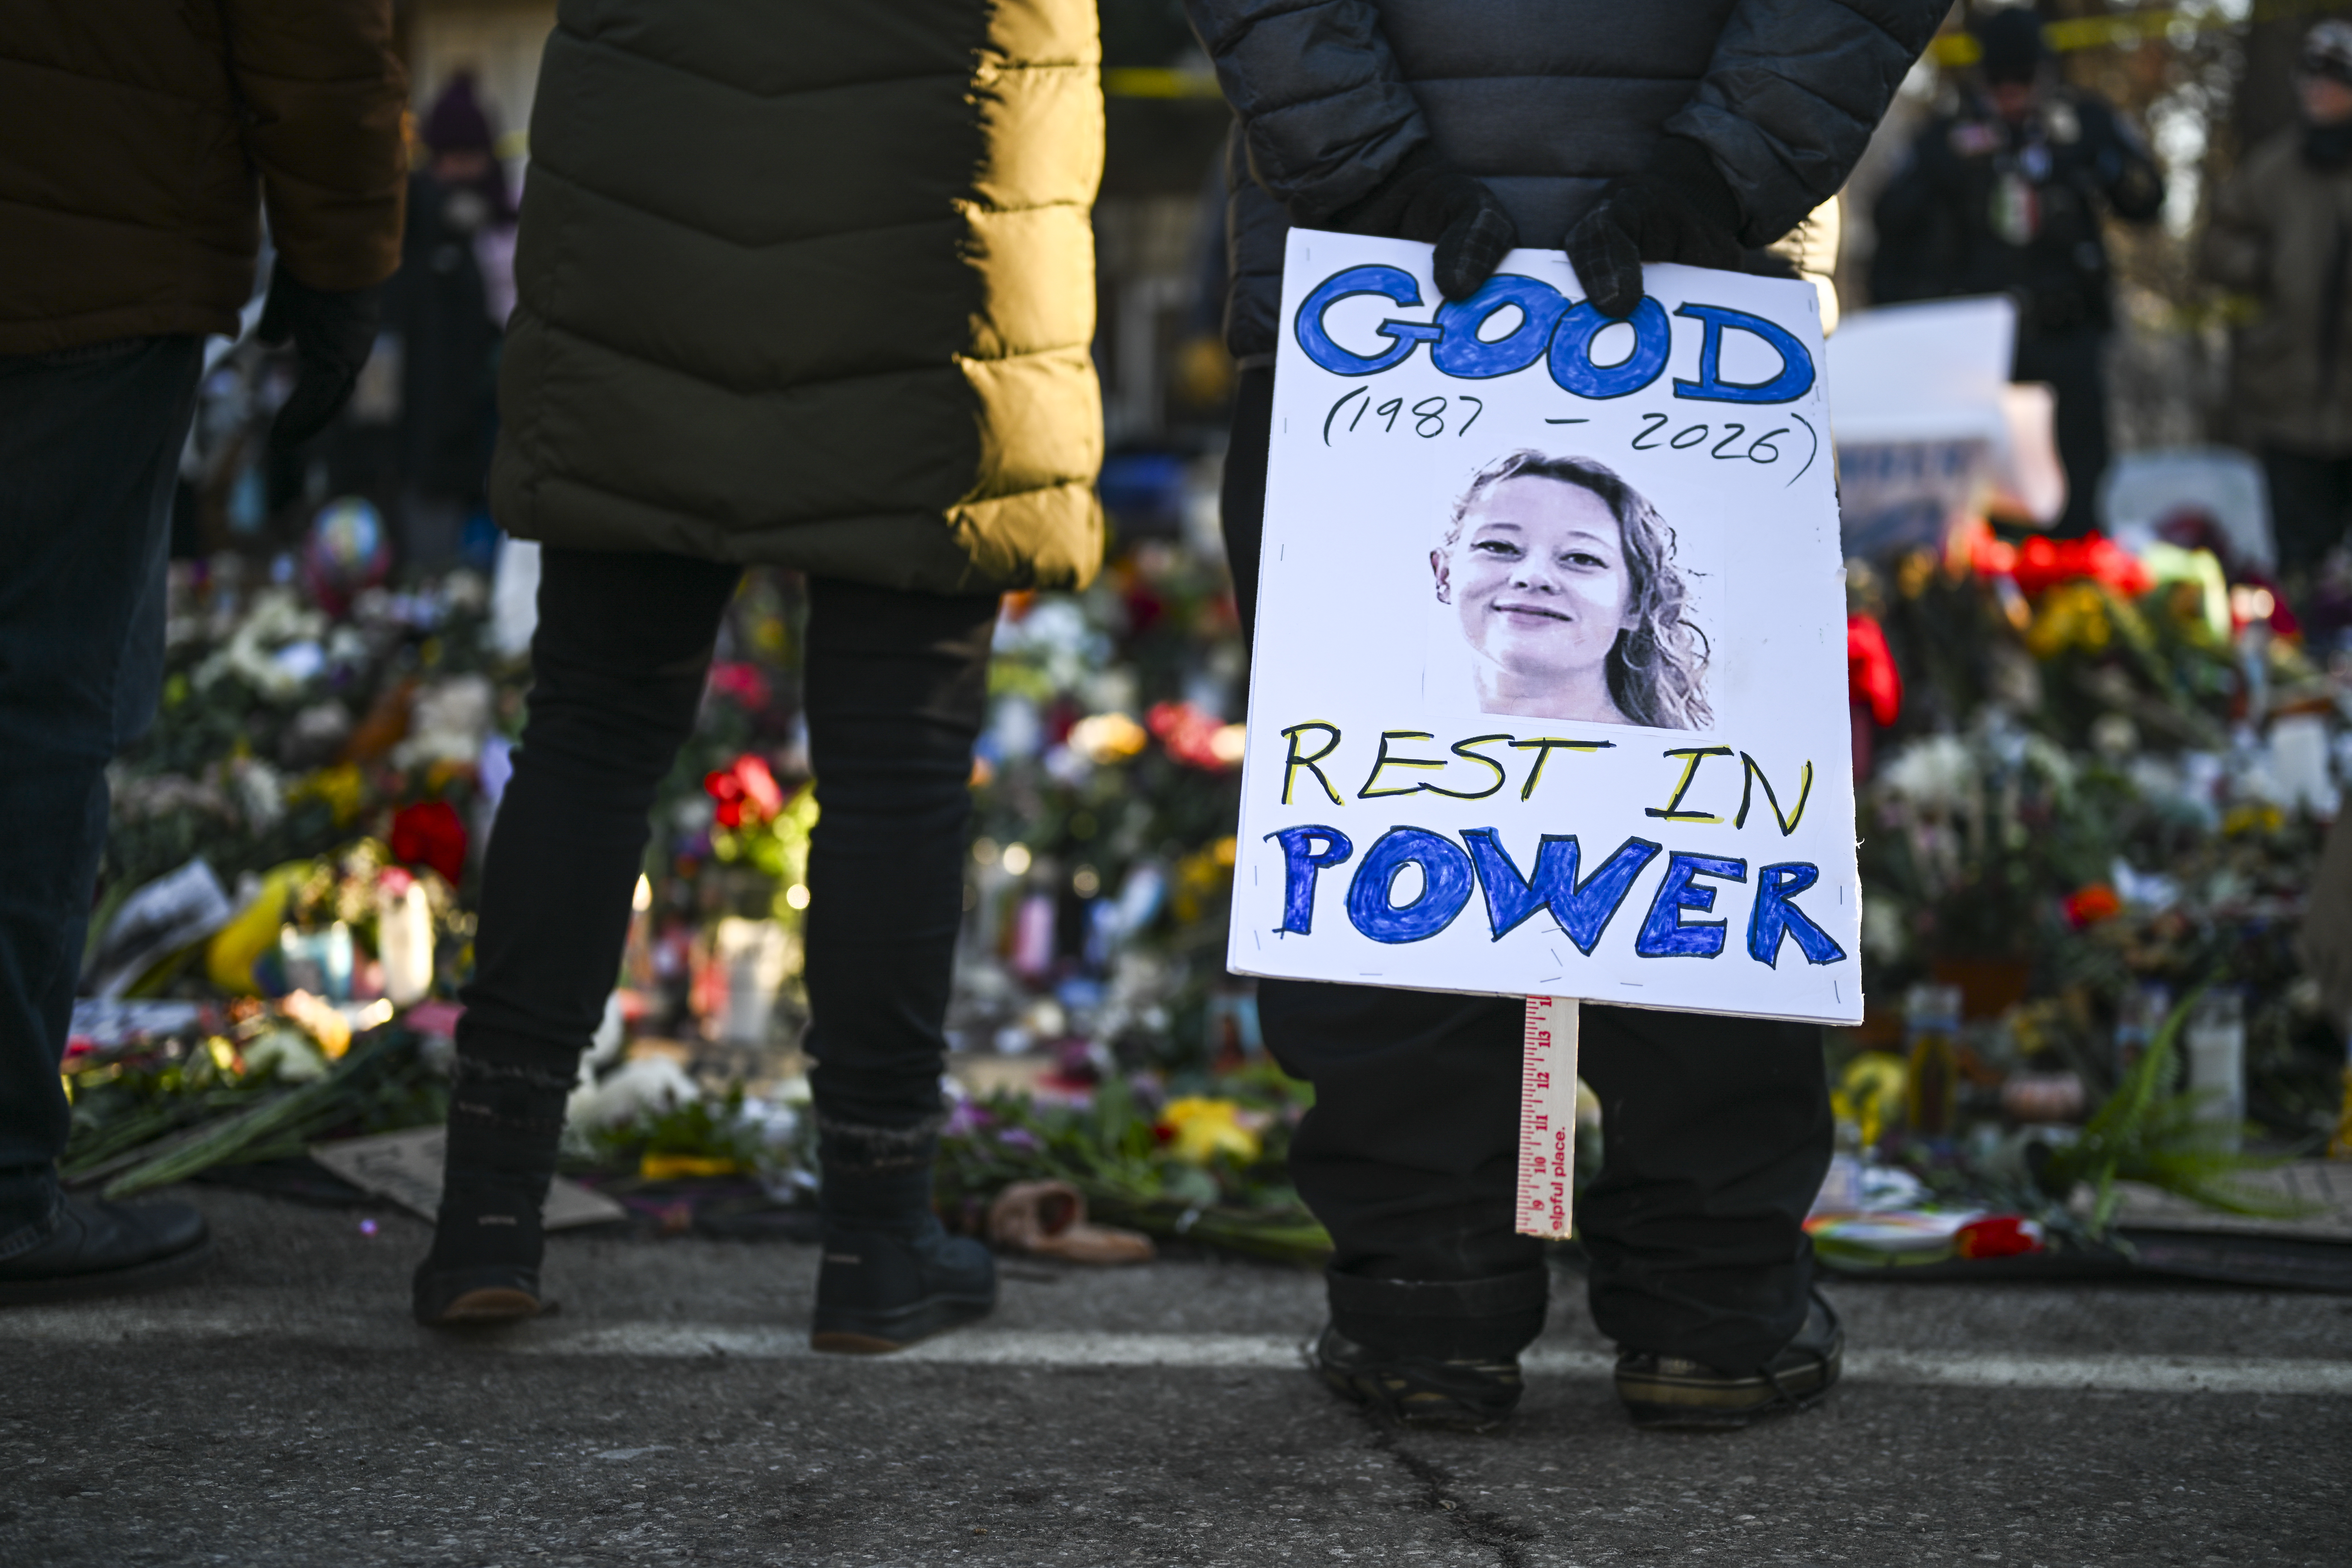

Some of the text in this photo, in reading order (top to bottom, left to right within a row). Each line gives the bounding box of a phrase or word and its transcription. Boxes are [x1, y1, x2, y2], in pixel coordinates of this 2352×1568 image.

[1294, 263, 1817, 405] GOOD
[1324, 385, 1483, 446] (1987
[1631, 412, 1817, 487] 2026)
[1280, 719, 1814, 837] REST IN
[1263, 824, 1847, 970] POWER
[1532, 995, 1552, 1211] 9 10 11 12 13 1
[1550, 1126, 1566, 1231] elpful place.
